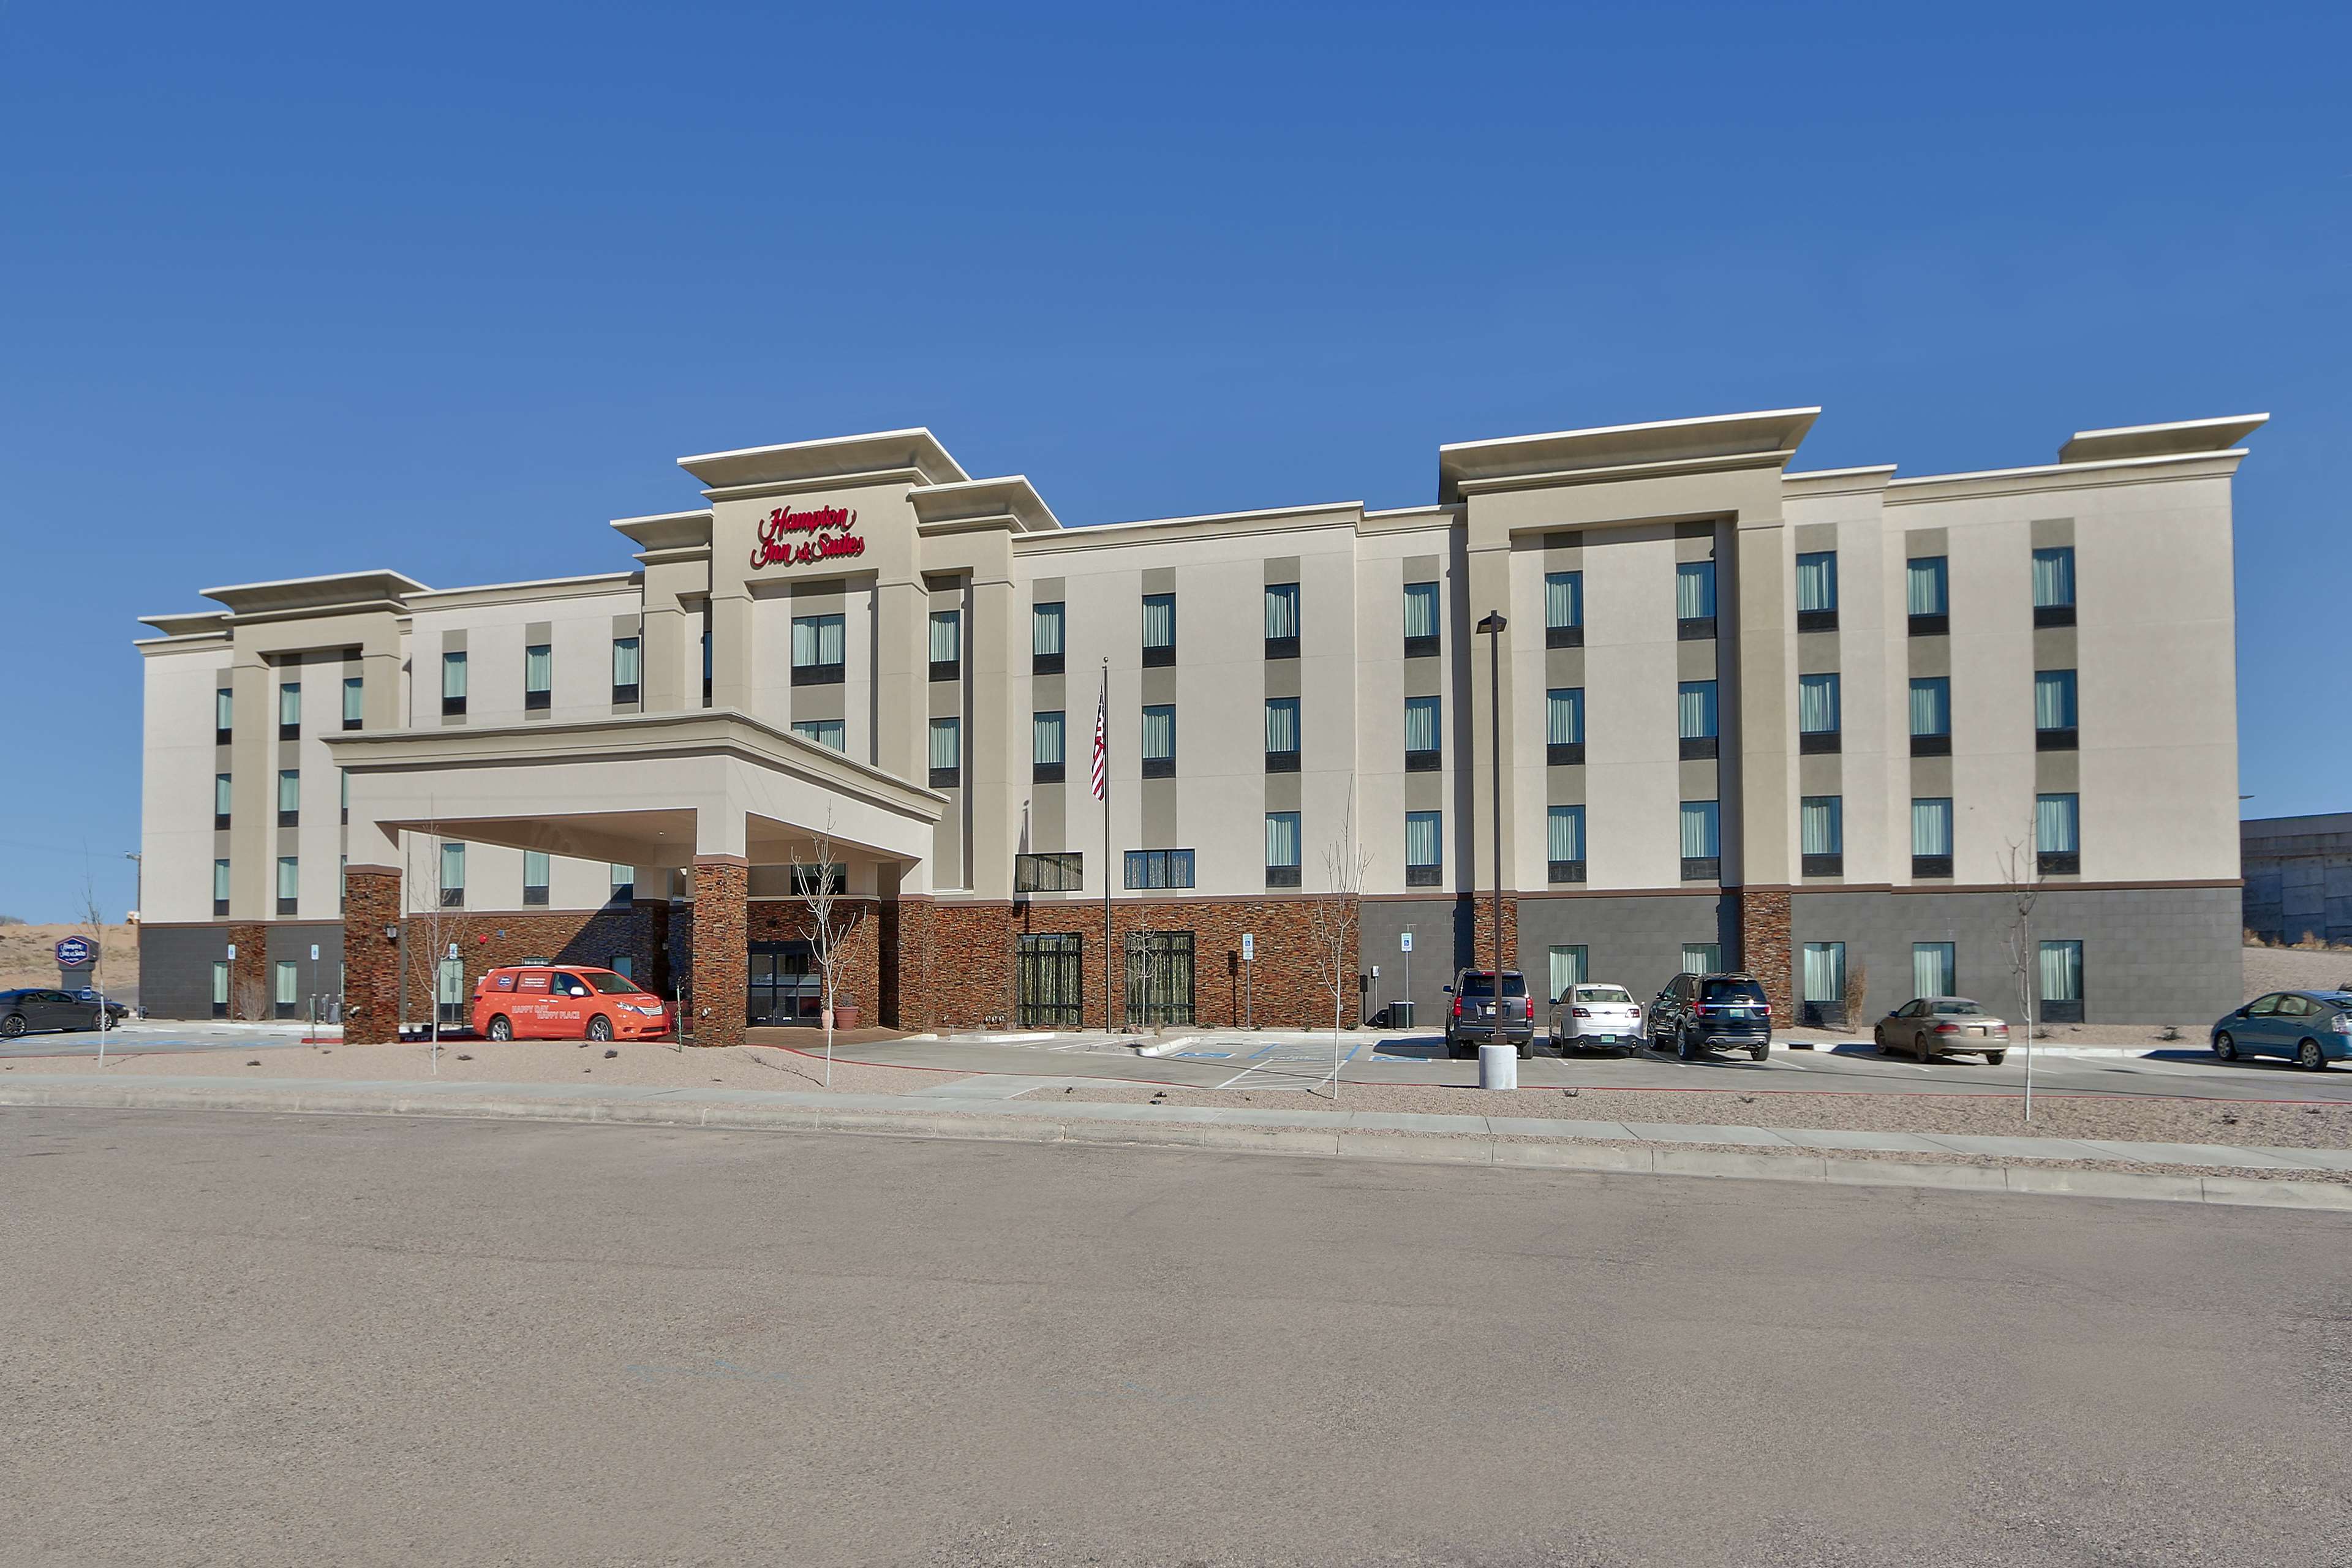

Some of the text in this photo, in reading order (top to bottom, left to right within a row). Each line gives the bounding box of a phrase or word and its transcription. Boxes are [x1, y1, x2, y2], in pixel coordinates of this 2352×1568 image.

[758, 505, 857, 541] Hampton
[750, 532, 865, 569] Inn & Suites
